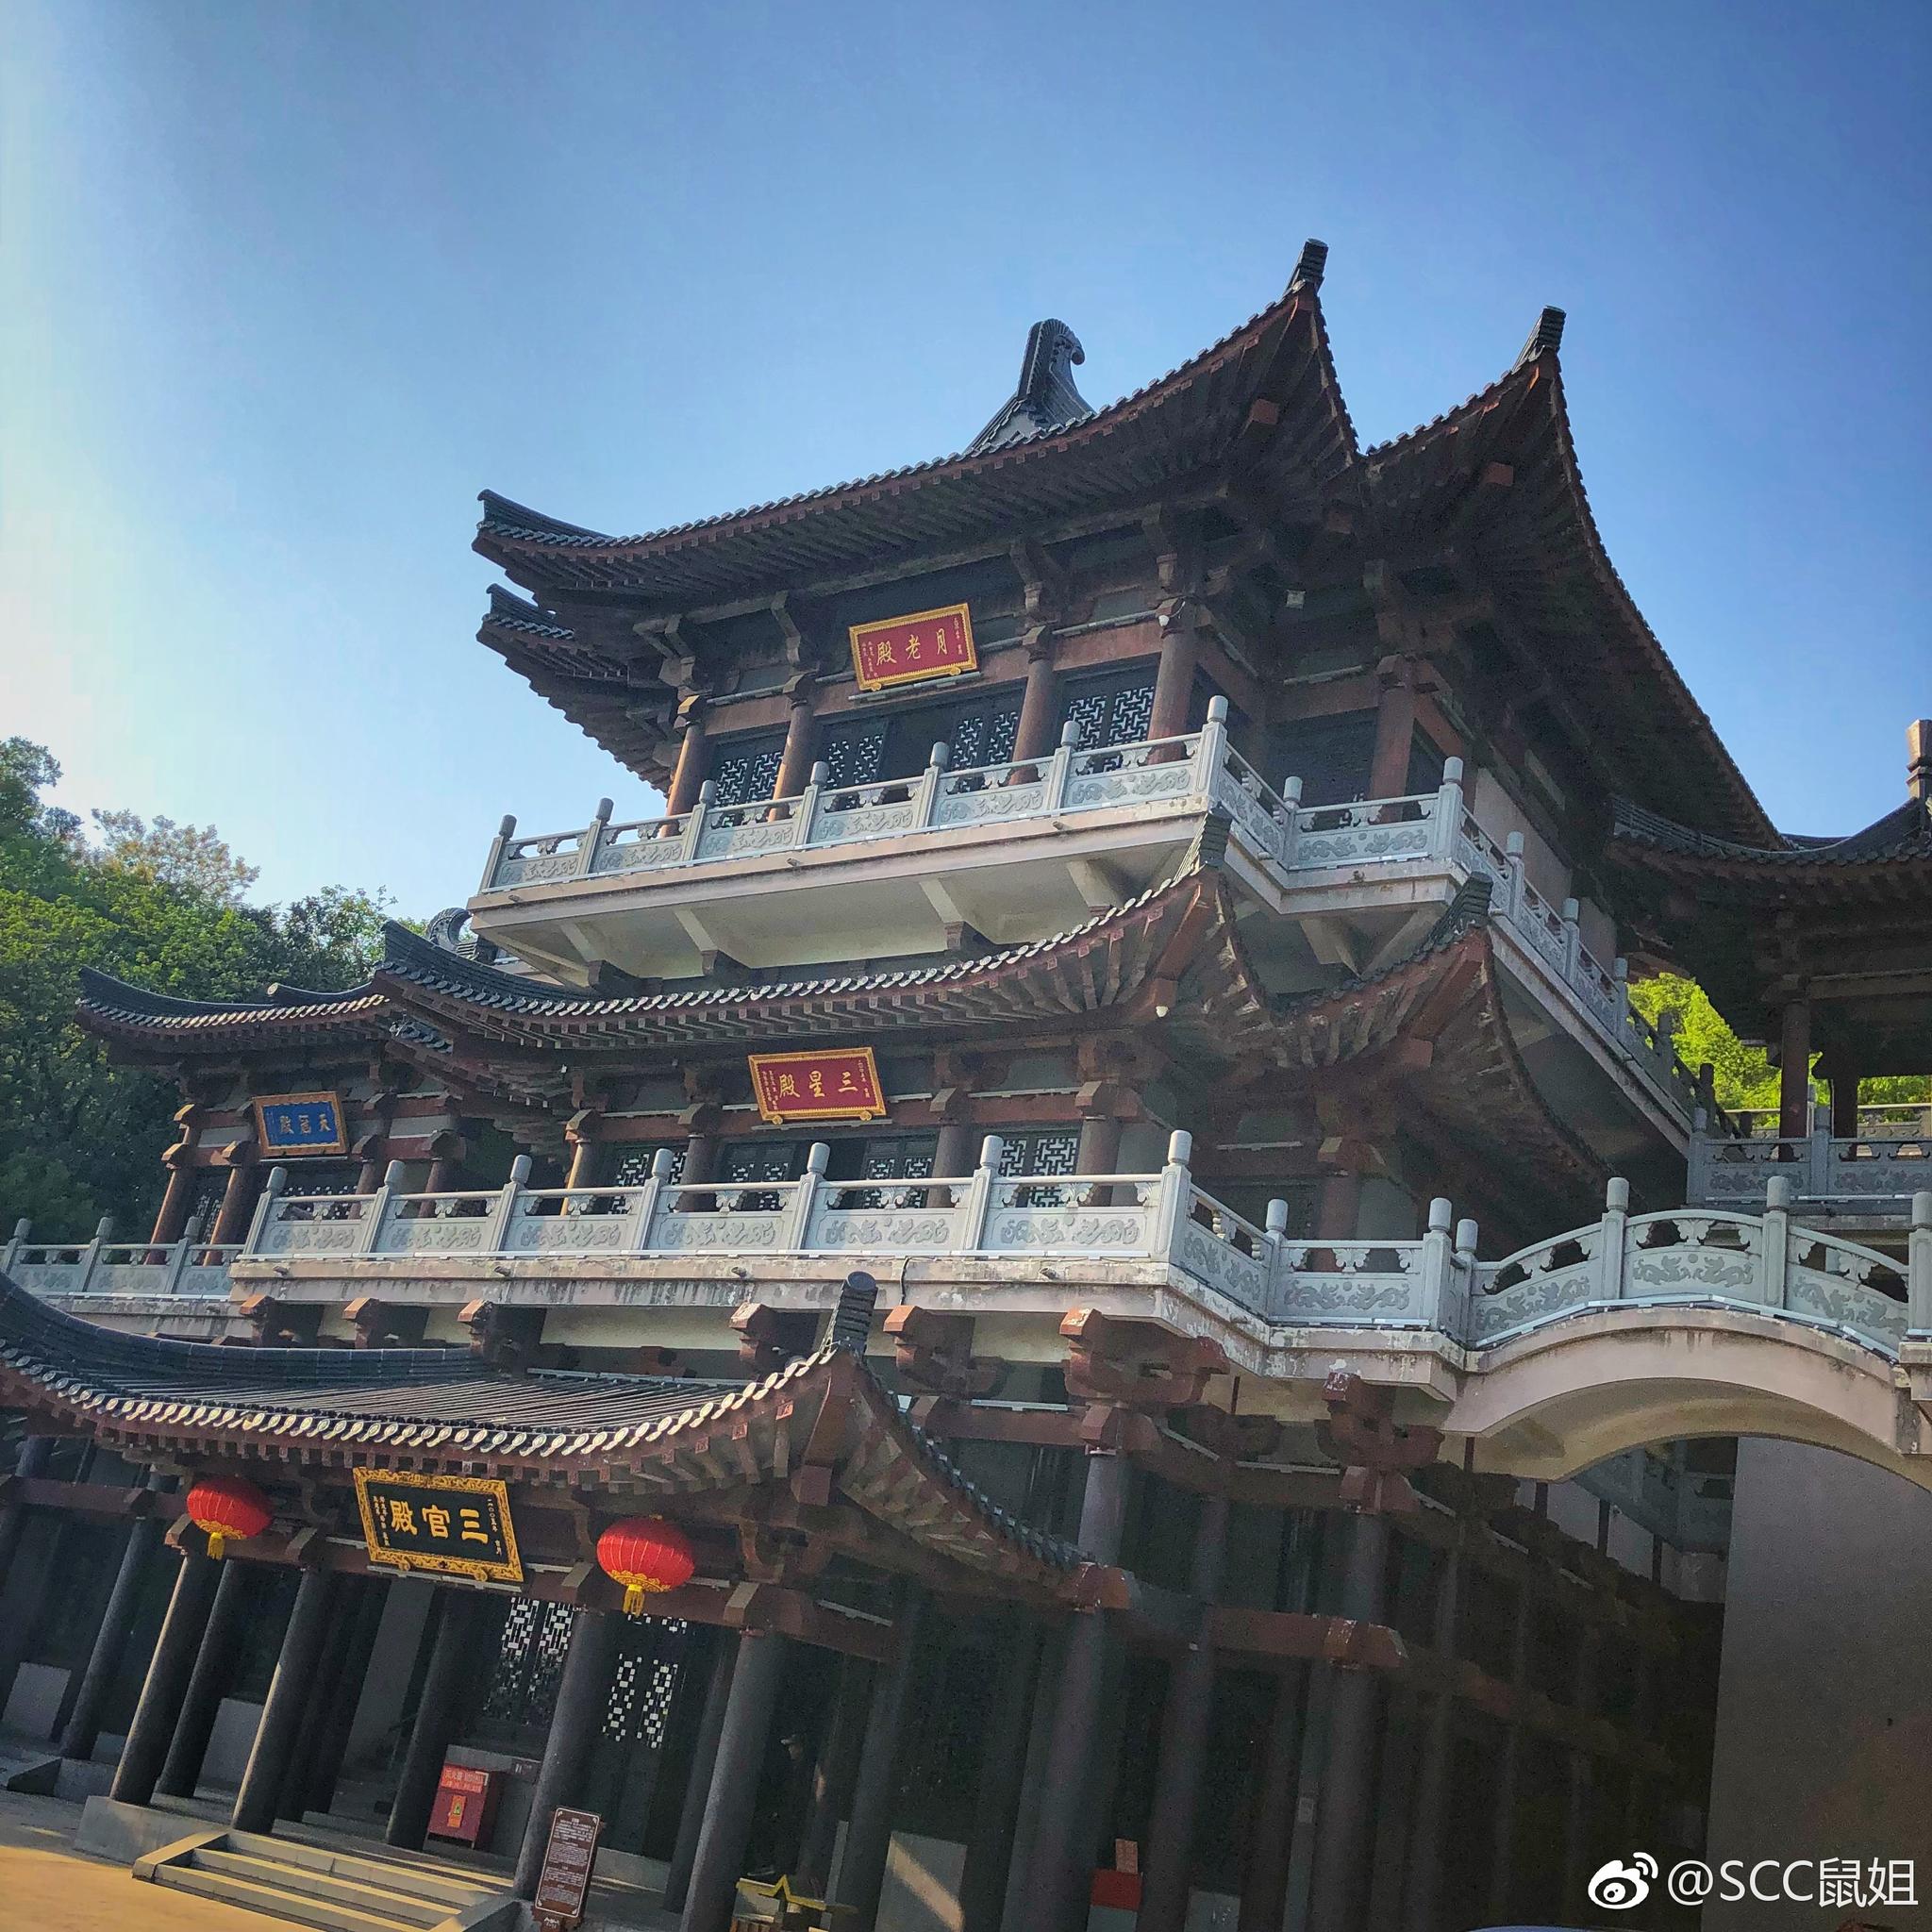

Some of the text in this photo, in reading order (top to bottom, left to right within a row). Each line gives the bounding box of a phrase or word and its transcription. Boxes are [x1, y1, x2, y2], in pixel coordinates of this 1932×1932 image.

[876, 628, 948, 666] 月老殿
[779, 1070, 858, 1098] 三星殿
[390, 1499, 489, 1544] 三官殿
